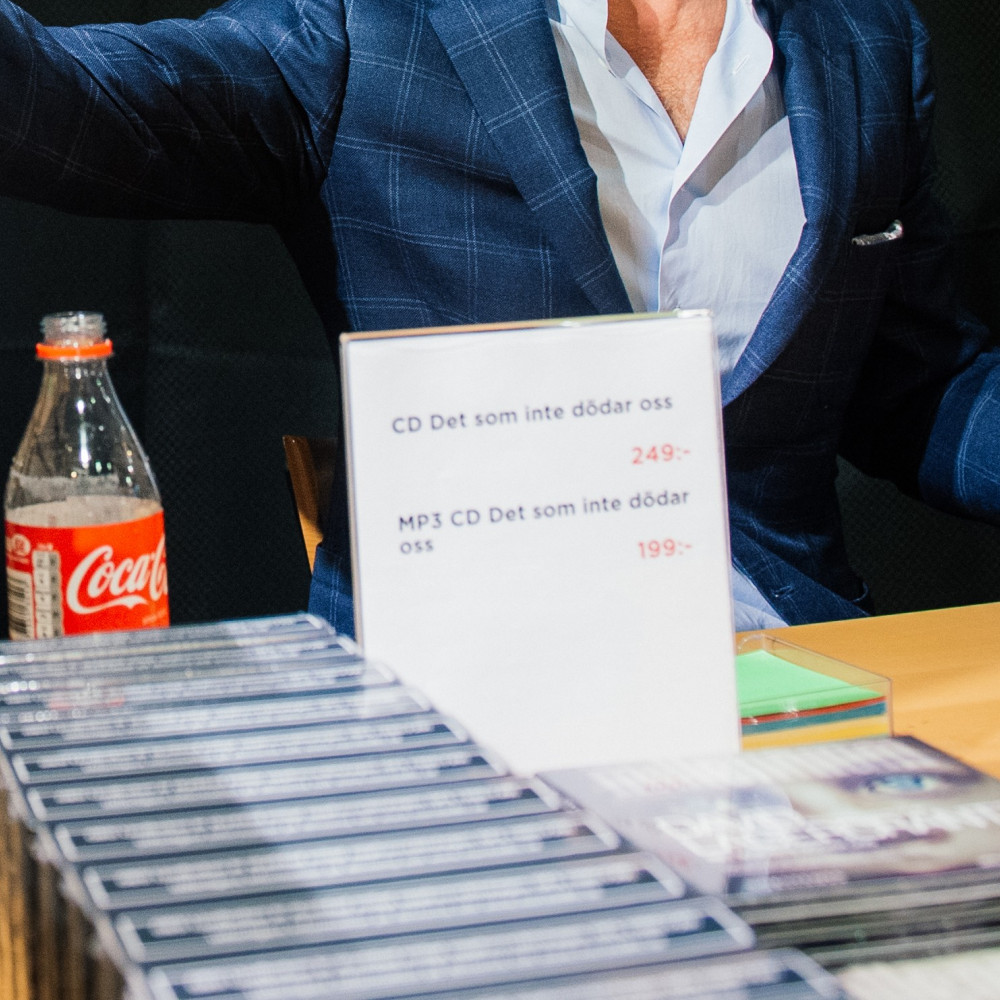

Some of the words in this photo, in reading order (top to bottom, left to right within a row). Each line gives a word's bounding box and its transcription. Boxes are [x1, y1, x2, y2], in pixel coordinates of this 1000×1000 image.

[392, 416, 422, 434] CD
[430, 413, 467, 431] Det
[475, 409, 517, 426] som
[525, 405, 565, 423] inte
[572, 398, 633, 418] dödar
[639, 396, 674, 411] oss
[631, 443, 692, 465] 249:-
[399, 511, 442, 532] MP3
[451, 509, 481, 527] CD
[489, 506, 525, 525] Det
[533, 502, 576, 520] som
[583, 496, 621, 514] inte
[629, 490, 690, 509] dödar
[400, 540, 434, 556] oss
[637, 538, 693, 559] 199:-
